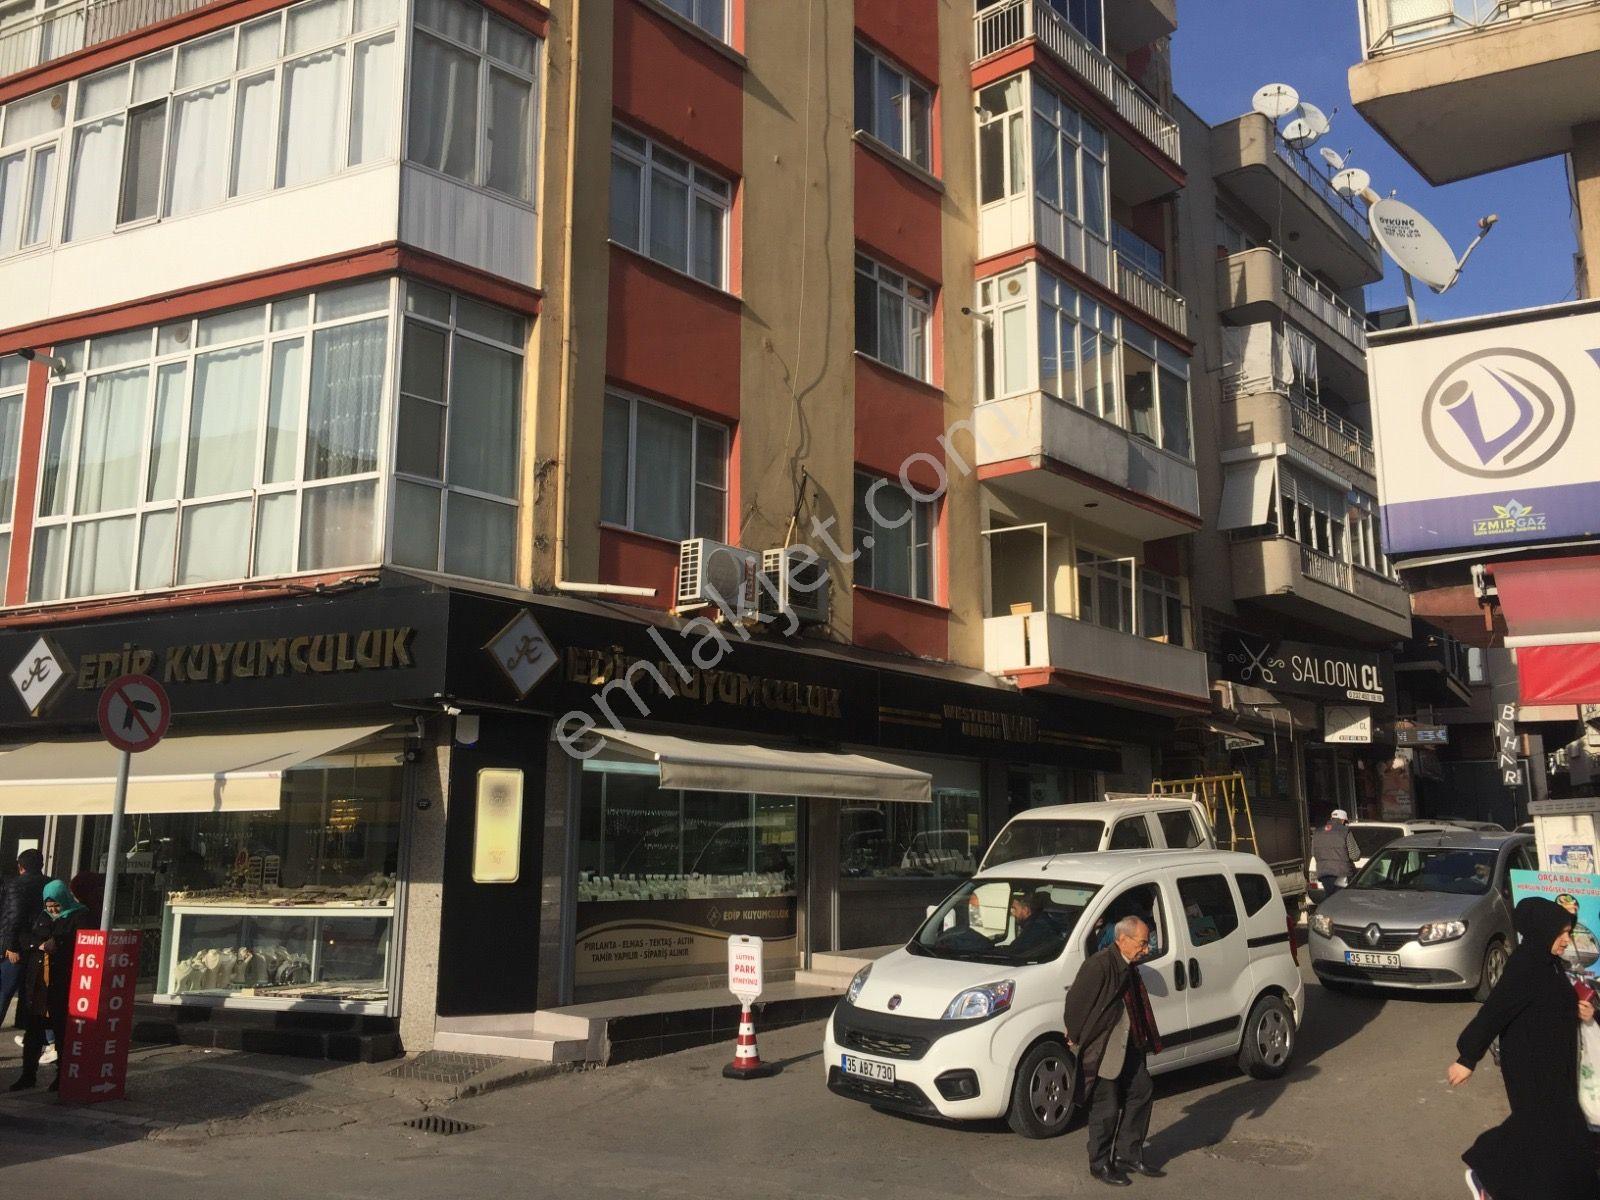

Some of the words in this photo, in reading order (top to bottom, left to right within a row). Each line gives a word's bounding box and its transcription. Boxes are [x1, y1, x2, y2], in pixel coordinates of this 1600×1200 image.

[76, 642, 156, 689] EDİP
[163, 627, 413, 684] KUYUMCULUK
[1291, 656, 1358, 689] SALOON
[1361, 665, 1383, 691] CL
[723, 909, 741, 921] EDİP
[77, 932, 104, 945] İZMİR
[108, 933, 137, 945] İZMİR
[583, 941, 617, 951] PIRLANTA
[622, 939, 643, 948] ELMAS
[650, 938, 672, 947] TEKTAŞ
[677, 936, 694, 945] ALTIN
[76, 953, 100, 969] 16.
[108, 953, 134, 968] 16.
[592, 951, 614, 962] TAMİR
[644, 949, 668, 960] SİPARİŞ
[1350, 953, 1361, 963] 35
[1365, 954, 1381, 964] EZT
[1388, 955, 1398, 965] 53
[734, 964, 756, 974] PARK
[847, 1058, 857, 1073] 35
[859, 1062, 874, 1077] ABZ
[876, 1064, 892, 1080] 730
